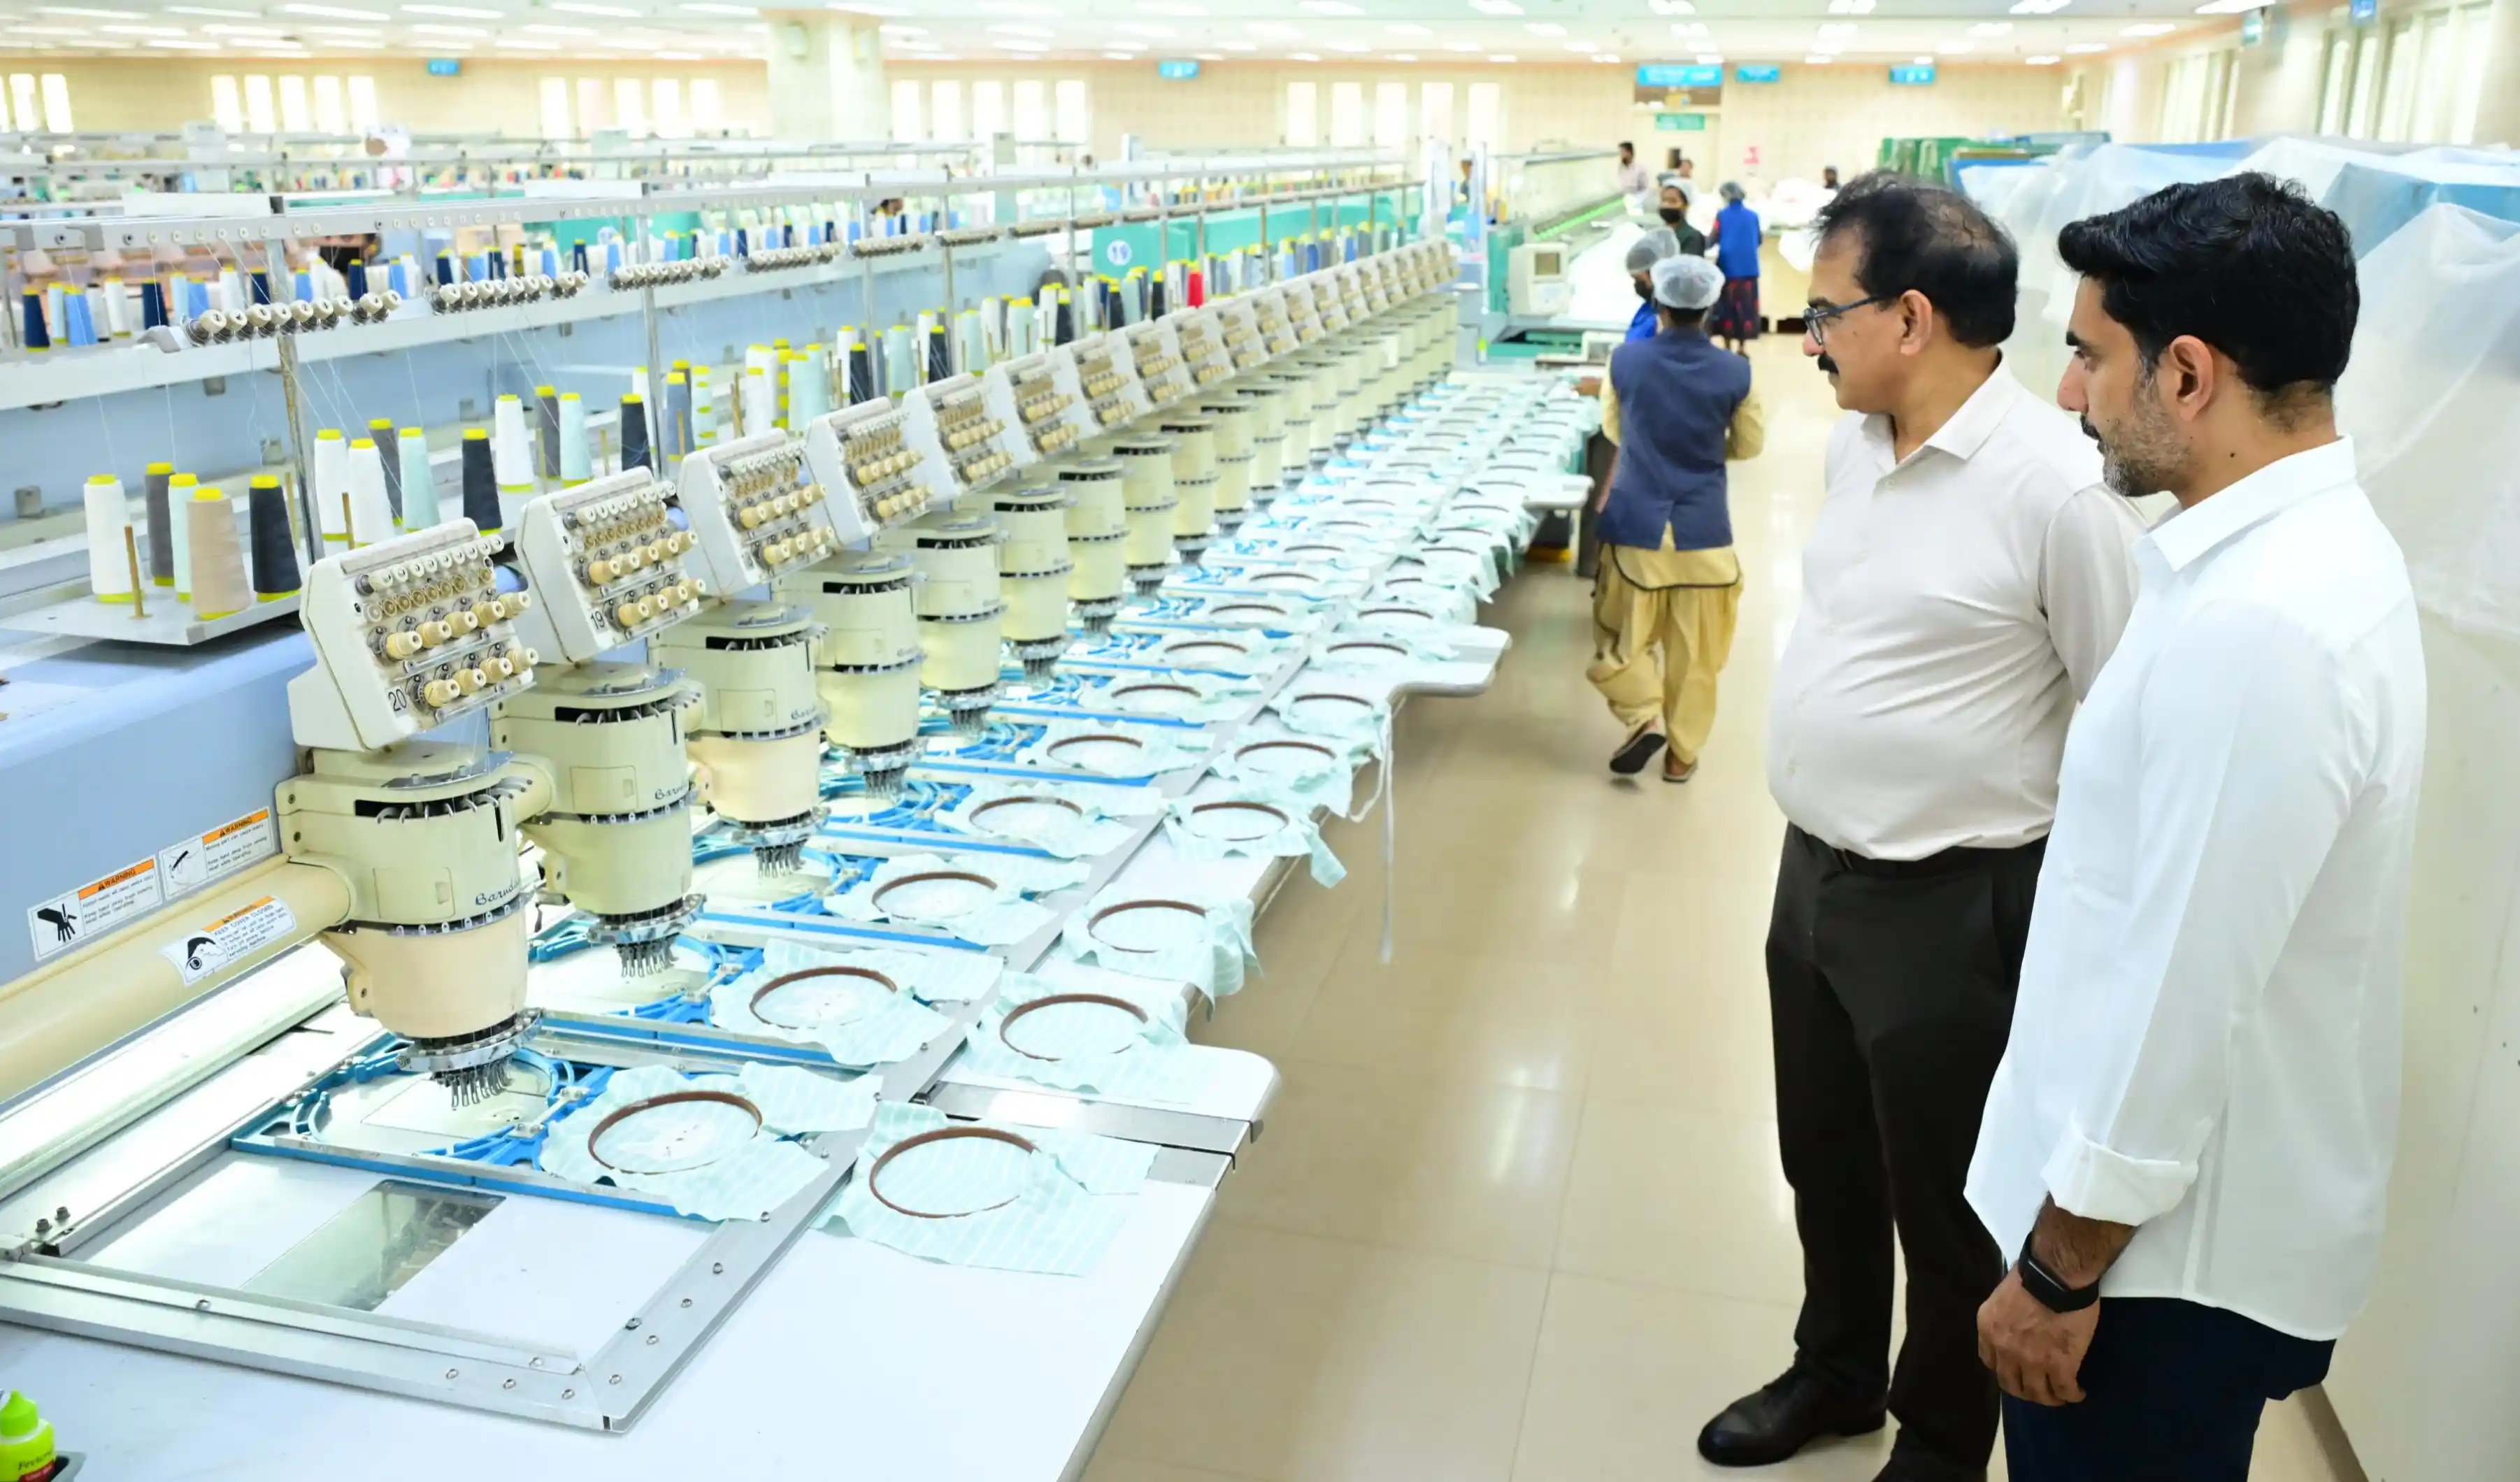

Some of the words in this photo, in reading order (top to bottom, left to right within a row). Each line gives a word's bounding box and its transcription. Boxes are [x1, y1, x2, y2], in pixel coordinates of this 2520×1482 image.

[589, 610, 605, 629] 19
[388, 689, 408, 712] 20
[225, 816, 252, 833] WARNING
[104, 869, 136, 886] WARNING
